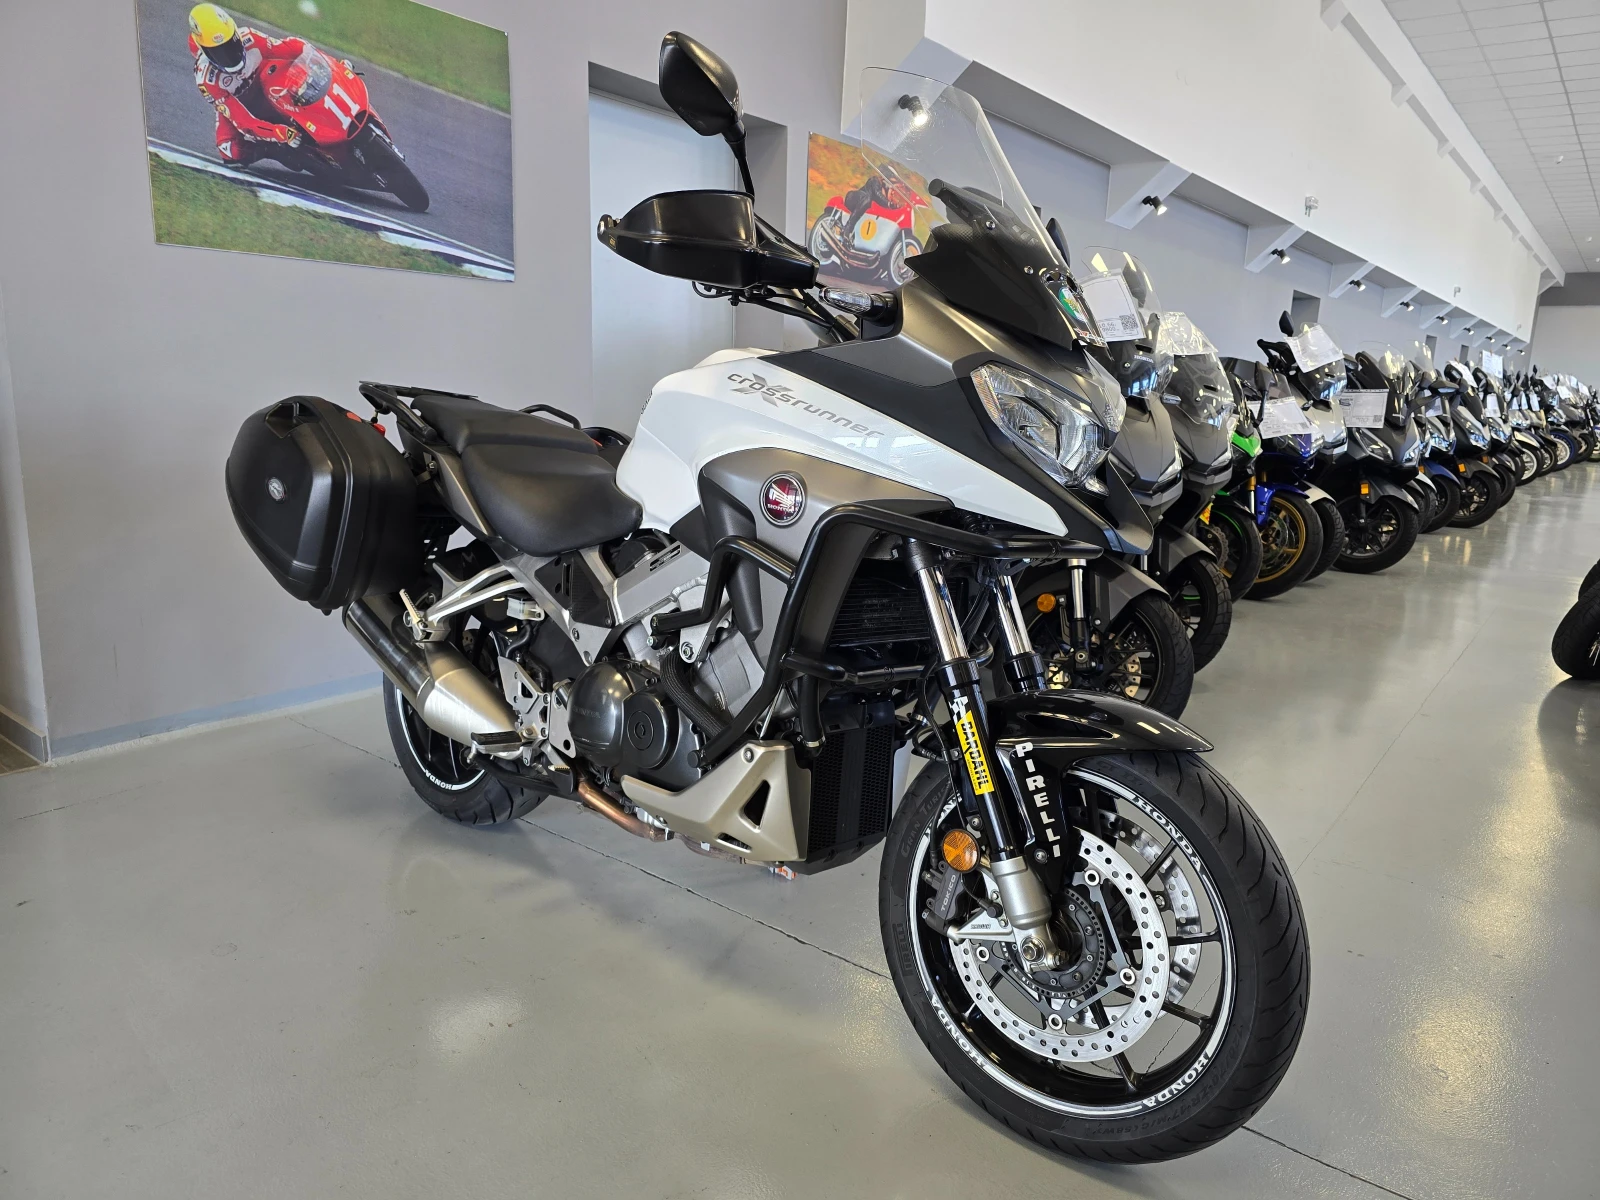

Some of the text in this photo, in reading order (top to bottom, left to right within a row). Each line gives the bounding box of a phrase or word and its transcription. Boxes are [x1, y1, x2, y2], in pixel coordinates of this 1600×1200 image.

[324, 83, 360, 131] 11
[866, 221, 871, 235] 1
[1134, 355, 1154, 363] HONDA
[727, 373, 885, 438] crossrunner
[767, 503, 795, 514] HONDA
[425, 769, 452, 790] HONDA
[961, 720, 989, 789] BARDAHL
[1015, 741, 1062, 858] PIRELLI
[1137, 798, 1201, 871] HONDA
[940, 874, 957, 912] TOKICO
[931, 994, 985, 1067] HONDA
[1142, 1056, 1211, 1108] HONDA
